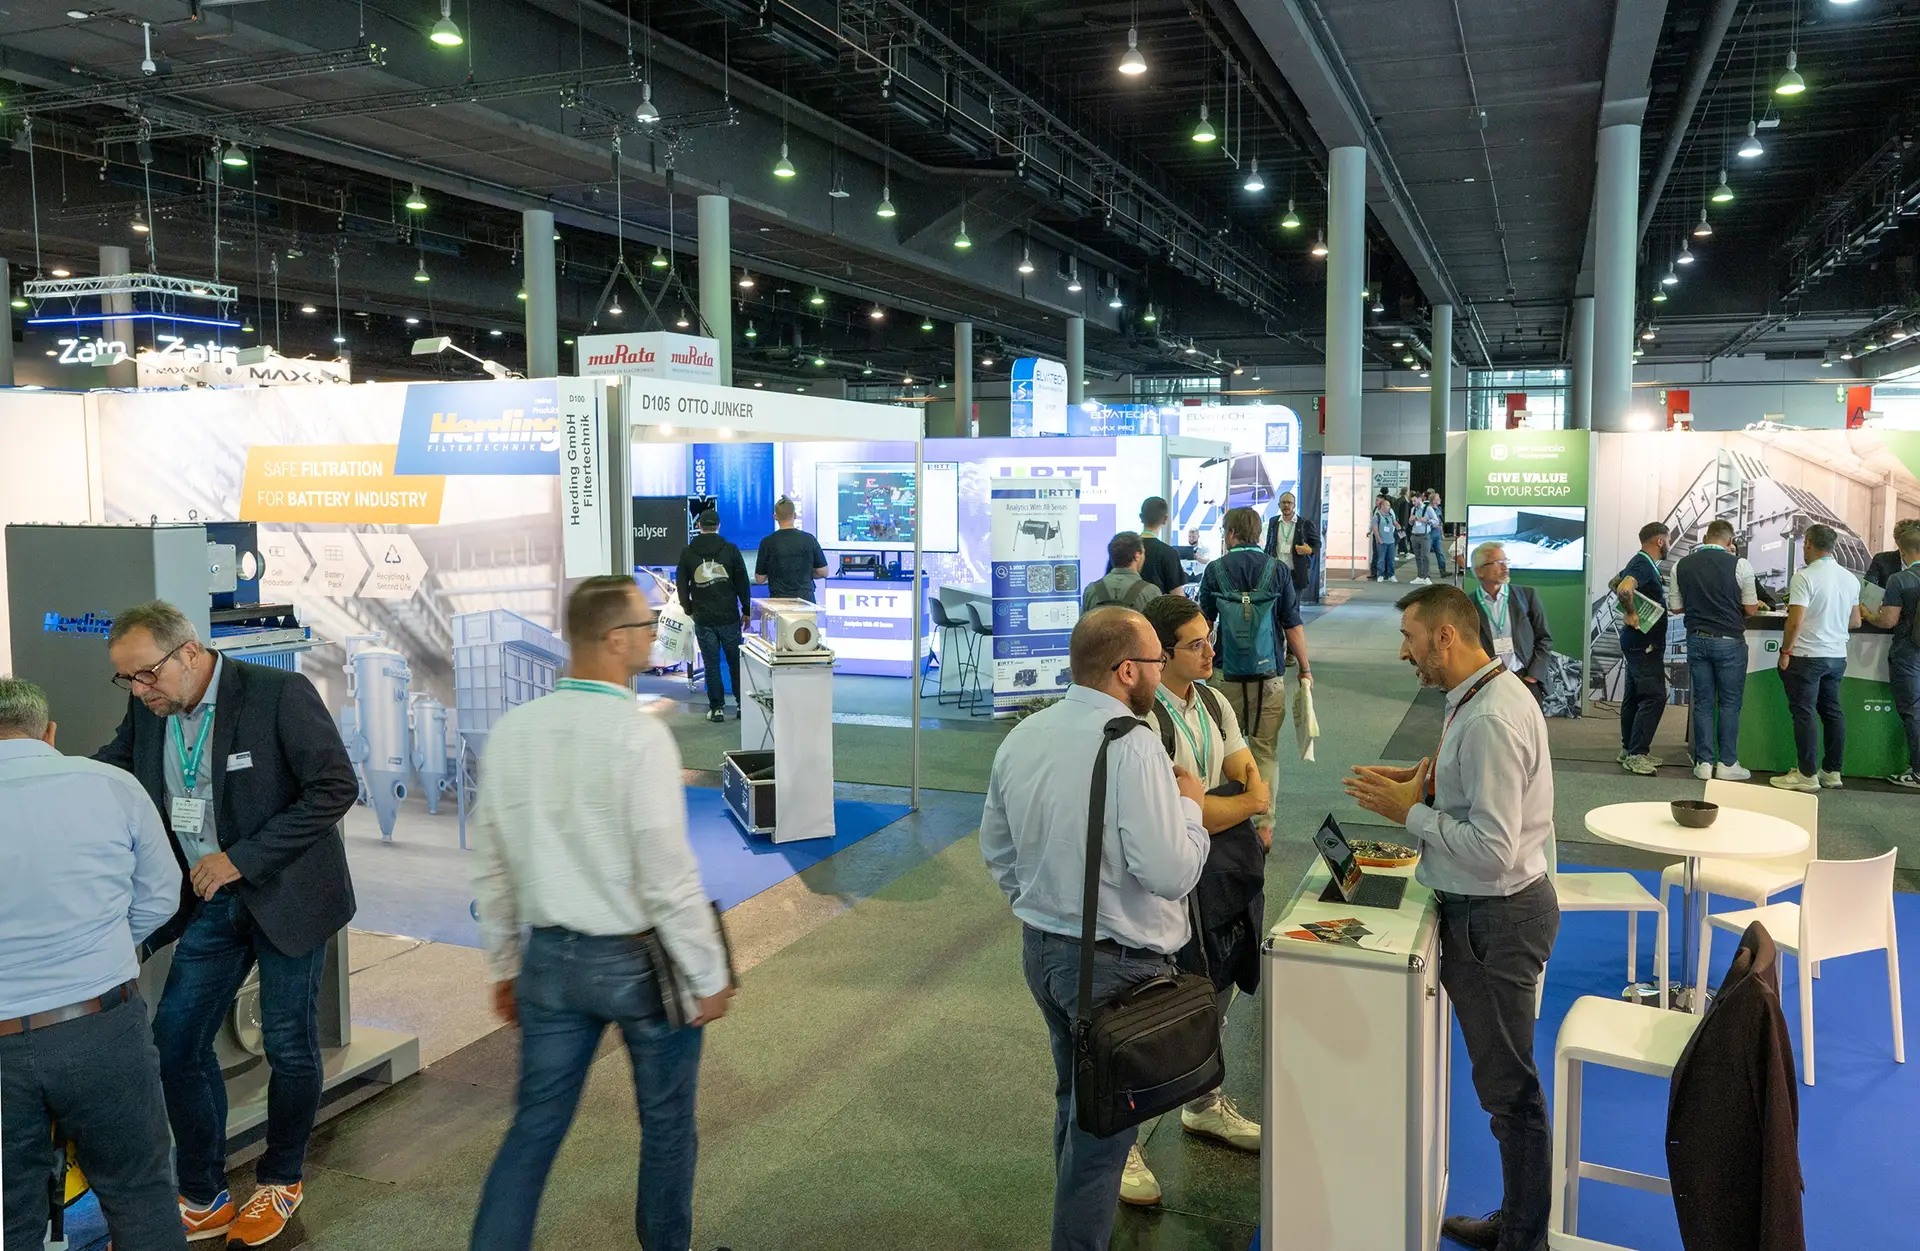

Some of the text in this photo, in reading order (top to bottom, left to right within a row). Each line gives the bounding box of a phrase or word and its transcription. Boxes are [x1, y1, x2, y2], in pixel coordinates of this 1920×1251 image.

[587, 344, 655, 366] muRata
[671, 346, 714, 367] muRata
[569, 394, 585, 403] D100
[642, 394, 753, 418] D105 OTTO JUNKER
[428, 408, 560, 452] Herding
[427, 443, 536, 452] FILTERTECHNIK
[580, 414, 593, 507] Filtertechnik
[264, 461, 383, 477] SAFE FILTRATION
[566, 414, 581, 525] Herding GmbH
[694, 459, 706, 498] enses
[1488, 472, 1568, 483] GIVE VALUE
[1048, 489, 1073, 497] RTT
[1485, 486, 1571, 497] TO YOUR SCRAP
[257, 491, 428, 507] FOR BATTERY INDUSTRY
[1006, 503, 1029, 512] Analytics
[1030, 503, 1042, 511] With
[1051, 503, 1068, 511] Senses
[324, 570, 345, 580] Battery
[376, 573, 404, 582] Recycling
[262, 579, 292, 587] Production
[327, 580, 343, 588] Pack
[376, 582, 398, 591] Second
[856, 594, 898, 608] RTT
[665, 616, 685, 629] RTT
